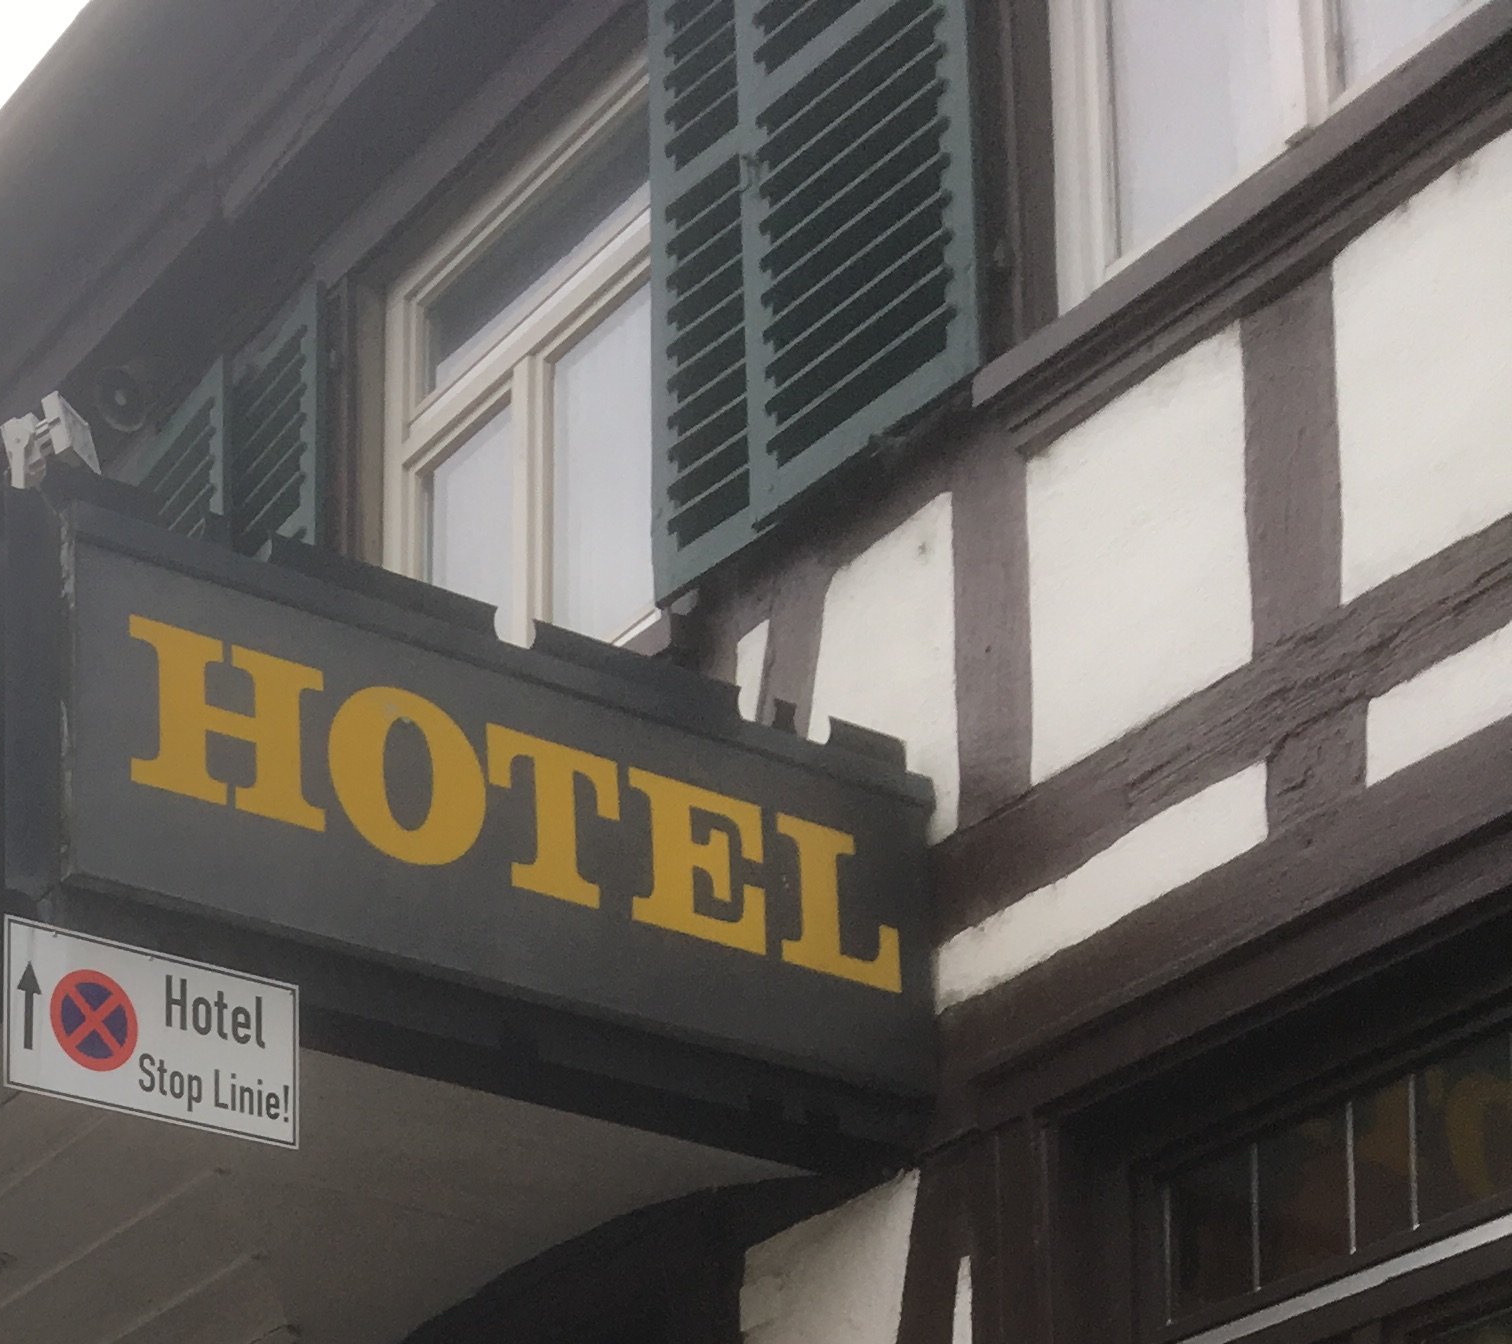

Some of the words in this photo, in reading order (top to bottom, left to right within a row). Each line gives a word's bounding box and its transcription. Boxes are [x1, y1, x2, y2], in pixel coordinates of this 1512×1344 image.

[128, 613, 903, 994] HOTEL
[165, 974, 266, 1049] Hotel
[138, 1053, 203, 1113] Stop
[214, 1068, 290, 1123] Linie!
